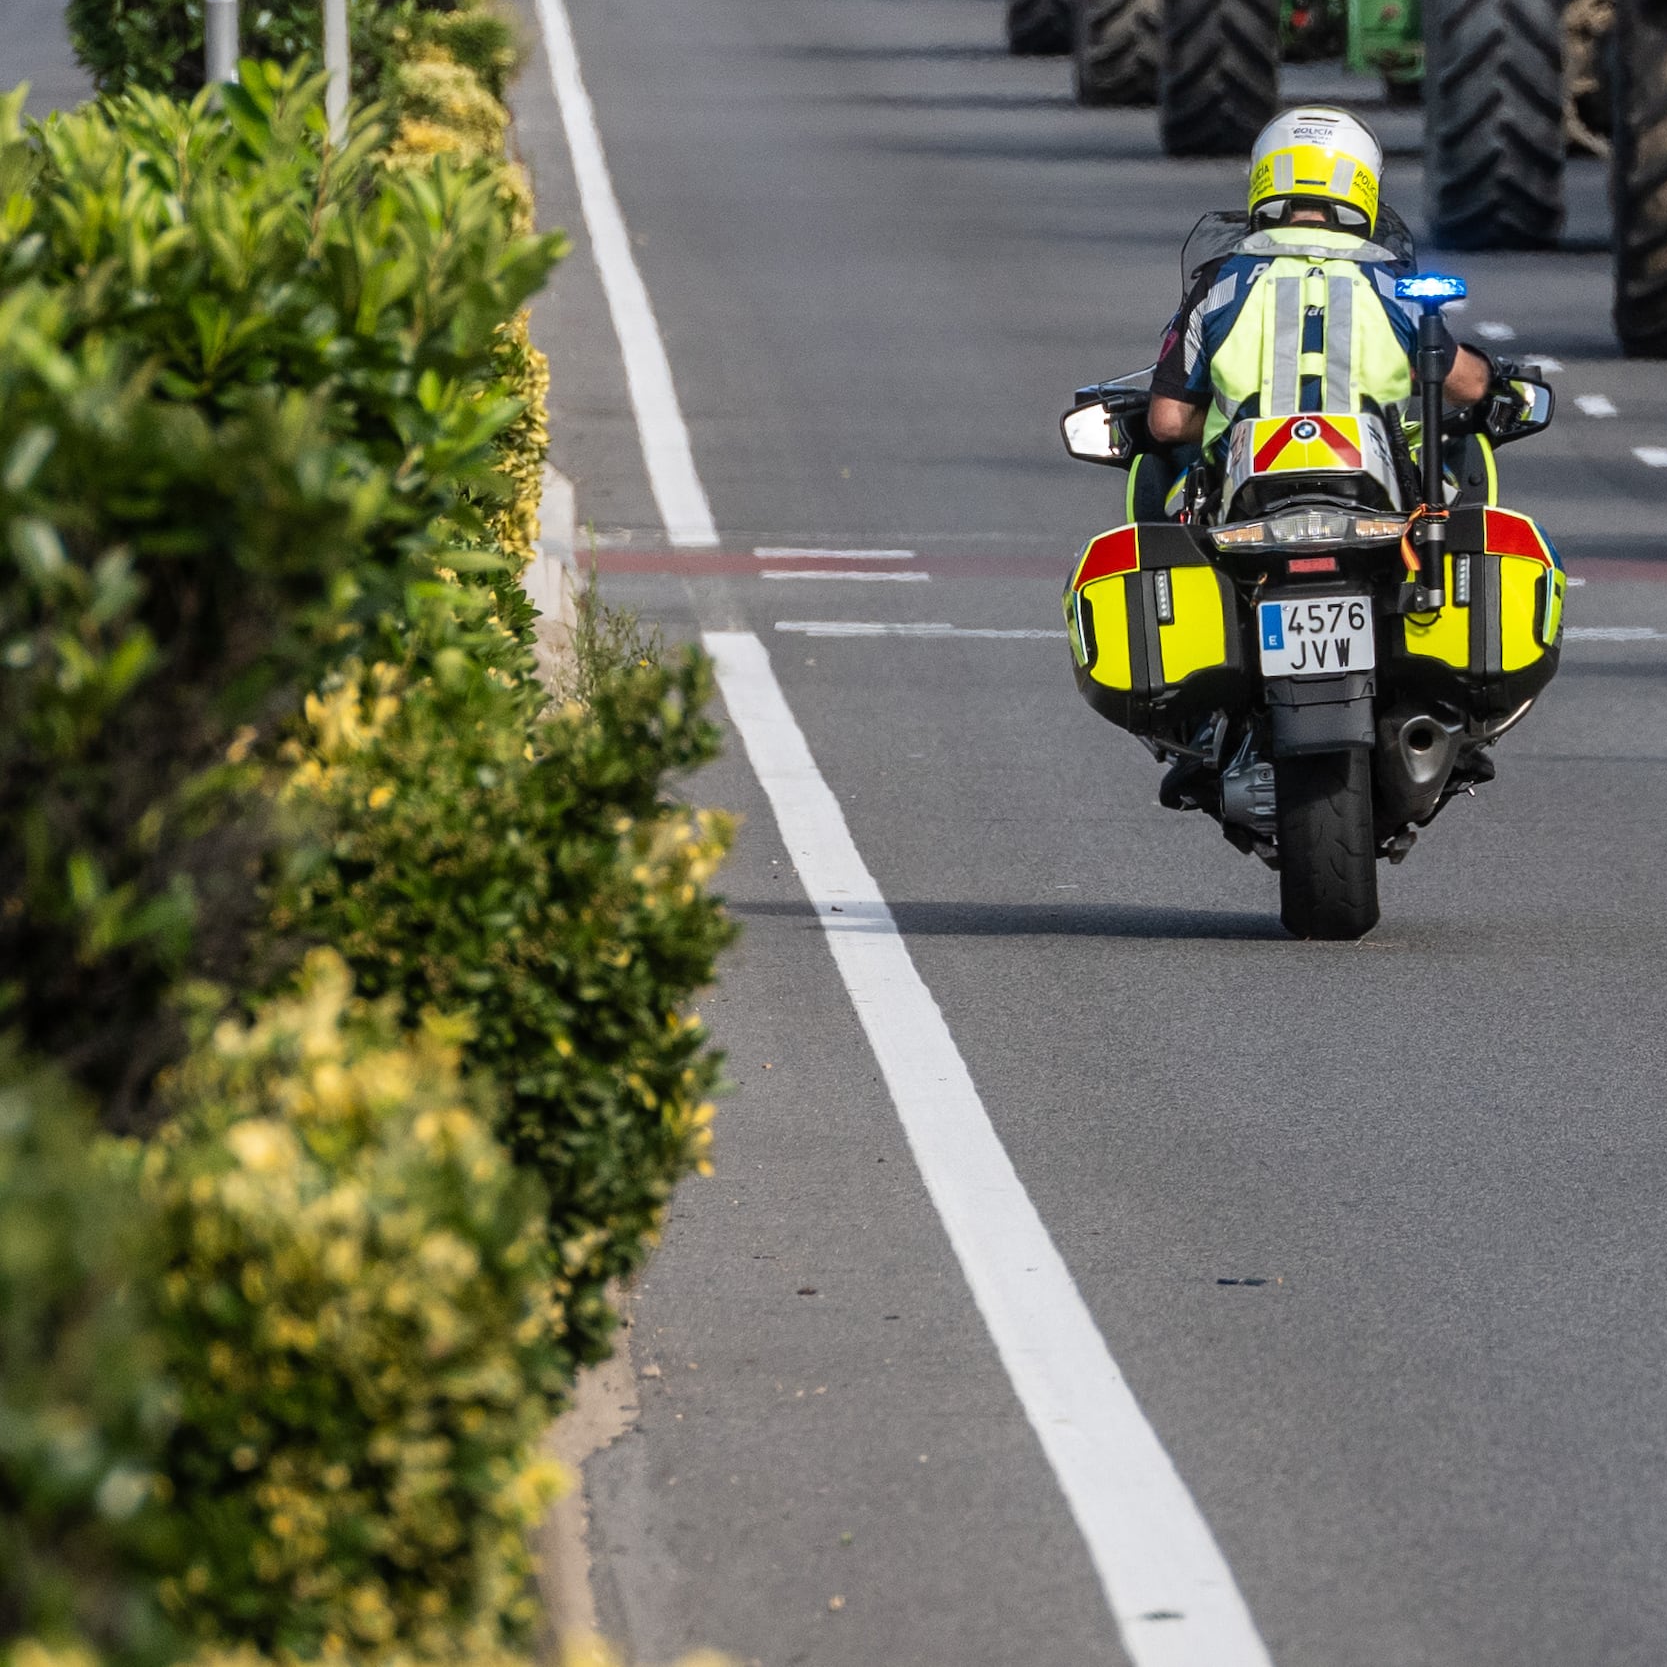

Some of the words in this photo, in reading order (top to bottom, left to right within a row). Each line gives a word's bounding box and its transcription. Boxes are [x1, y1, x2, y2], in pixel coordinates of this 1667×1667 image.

[1288, 602, 1365, 636] 4576
[1268, 635, 1278, 646] E
[1290, 637, 1351, 670] JVW
